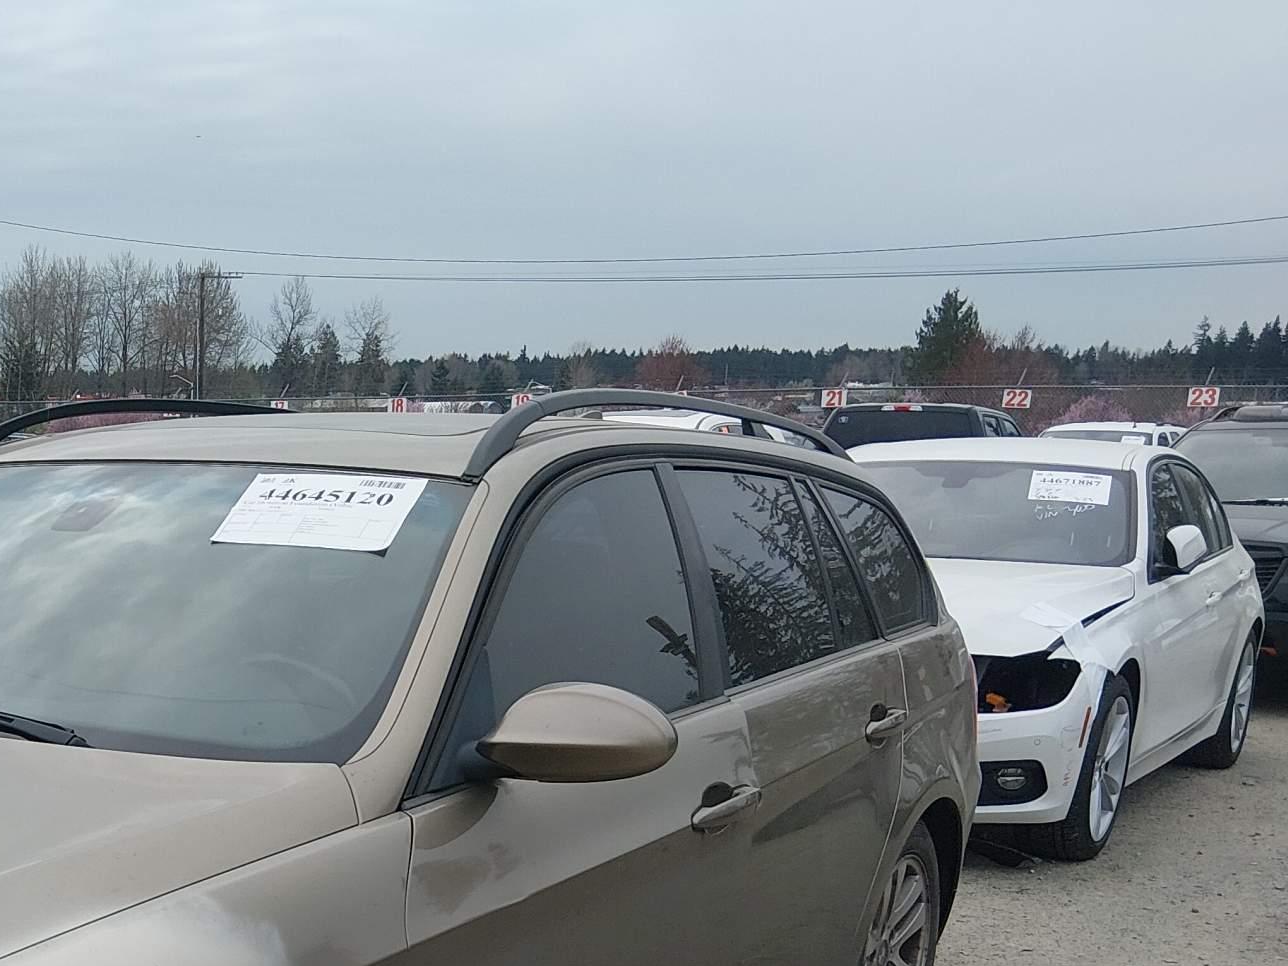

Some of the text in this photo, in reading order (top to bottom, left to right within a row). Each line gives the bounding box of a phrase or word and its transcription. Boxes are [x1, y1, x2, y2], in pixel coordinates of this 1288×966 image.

[392, 398, 404, 413] 18
[825, 391, 843, 406] 21
[1004, 390, 1029, 407] 22
[1190, 388, 1217, 406] 23
[259, 487, 394, 507] 44645120
